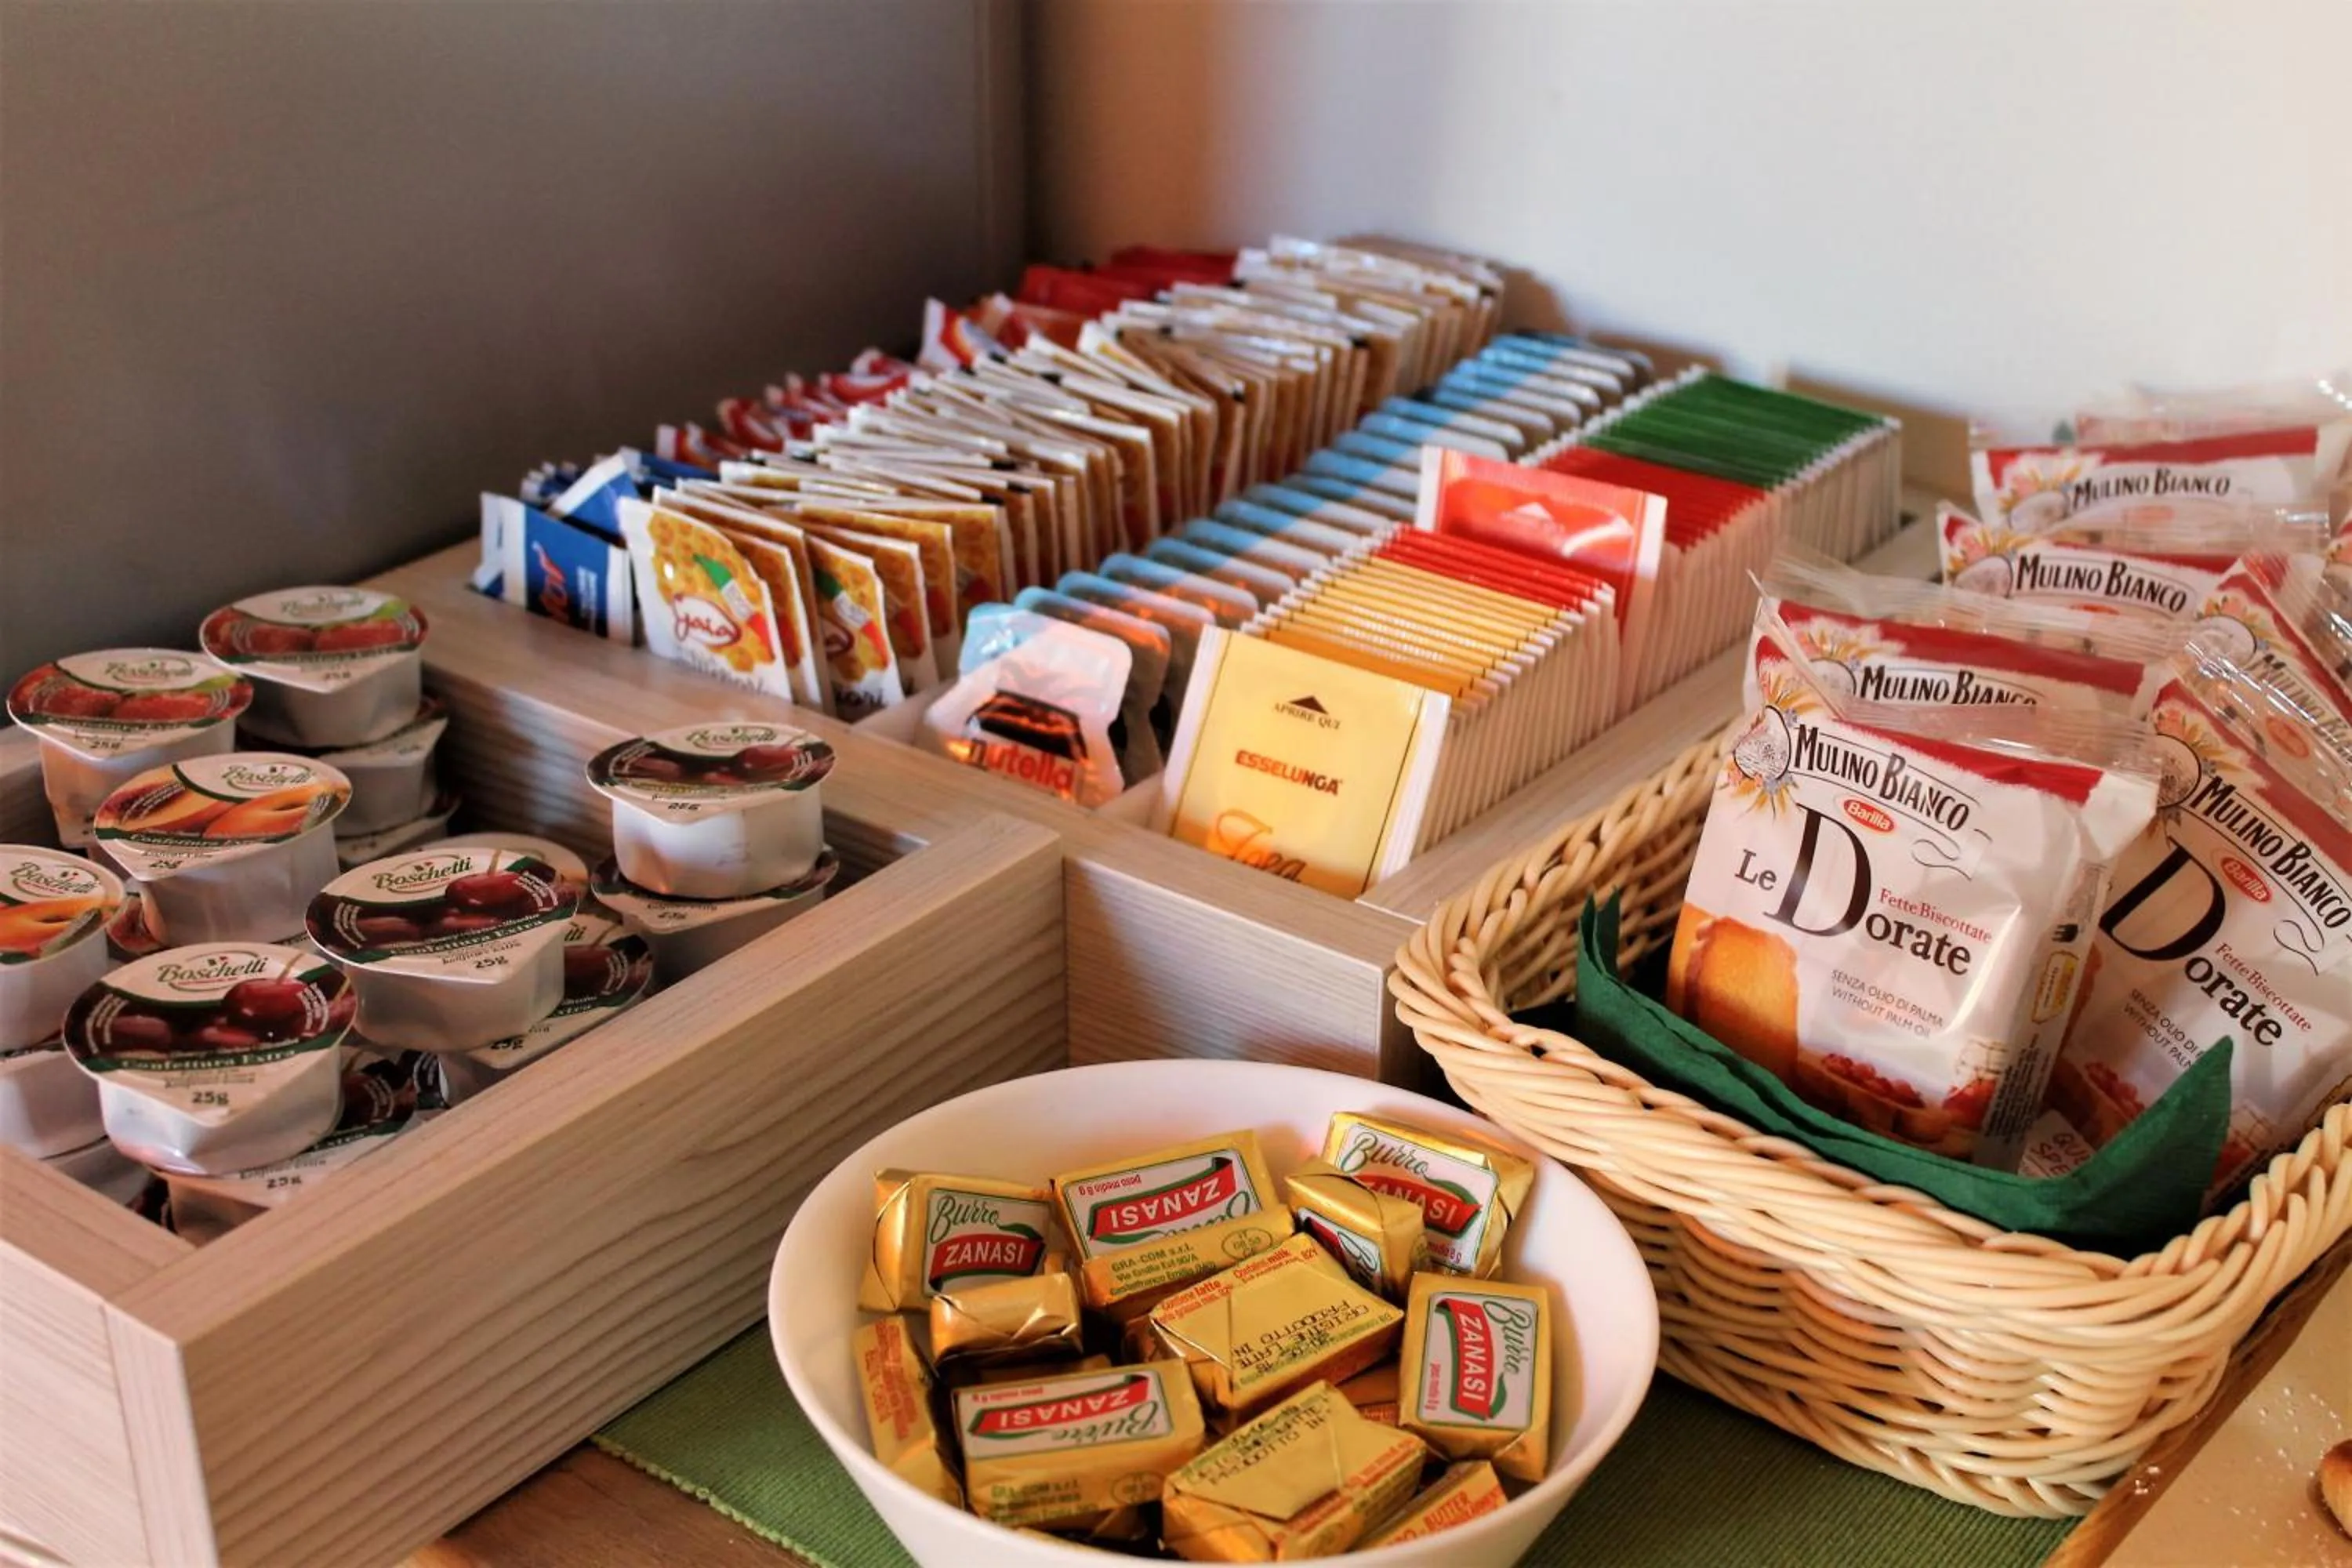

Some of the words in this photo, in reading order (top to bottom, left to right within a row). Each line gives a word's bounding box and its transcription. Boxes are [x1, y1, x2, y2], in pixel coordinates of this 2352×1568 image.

[2072, 478, 2150, 509] MULINO
[2154, 467, 2230, 497] BIANCO
[2016, 555, 2103, 590] MULINO
[2104, 561, 2187, 612] BIANCO
[1860, 665, 1951, 702] MULINO
[969, 739, 1076, 793] nutella
[1235, 748, 1340, 797] ESSELUNGA
[1794, 723, 1880, 788] MULINO
[1878, 752, 1971, 832] BIANCO
[1846, 800, 1891, 831] Barilla
[372, 856, 473, 890] Boschetti
[2190, 775, 2285, 858] MULINO
[2269, 840, 2351, 929] BIANCO
[1734, 849, 1777, 891] Le
[1763, 803, 1972, 975] Dorate
[2224, 859, 2269, 902] Barilla
[2099, 835, 2283, 1046] Dorate
[157, 956, 270, 983] Boschetti
[1831, 969, 1866, 993] SENZA
[1868, 985, 1895, 1004] OLIO
[1896, 998, 1911, 1011] DI
[1910, 1004, 1943, 1027] PALMA
[1831, 985, 1886, 1017] WITHOUT
[1886, 1011, 1913, 1031] PALM
[2160, 1017, 2186, 1041] OLIO
[191, 1091, 230, 1106] 25g
[1341, 1131, 1429, 1174] Burro
[930, 1194, 1000, 1244] Burro
[1109, 1177, 1221, 1229] ZANASI
[1367, 1181, 1458, 1224] ANASI
[943, 1240, 1025, 1267] ZANASI
[1458, 1312, 1487, 1402] ZANASI
[1483, 1300, 1533, 1374] Burro
[1000, 1388, 1131, 1428] ZANASI
[1052, 1400, 1159, 1443] Burro
